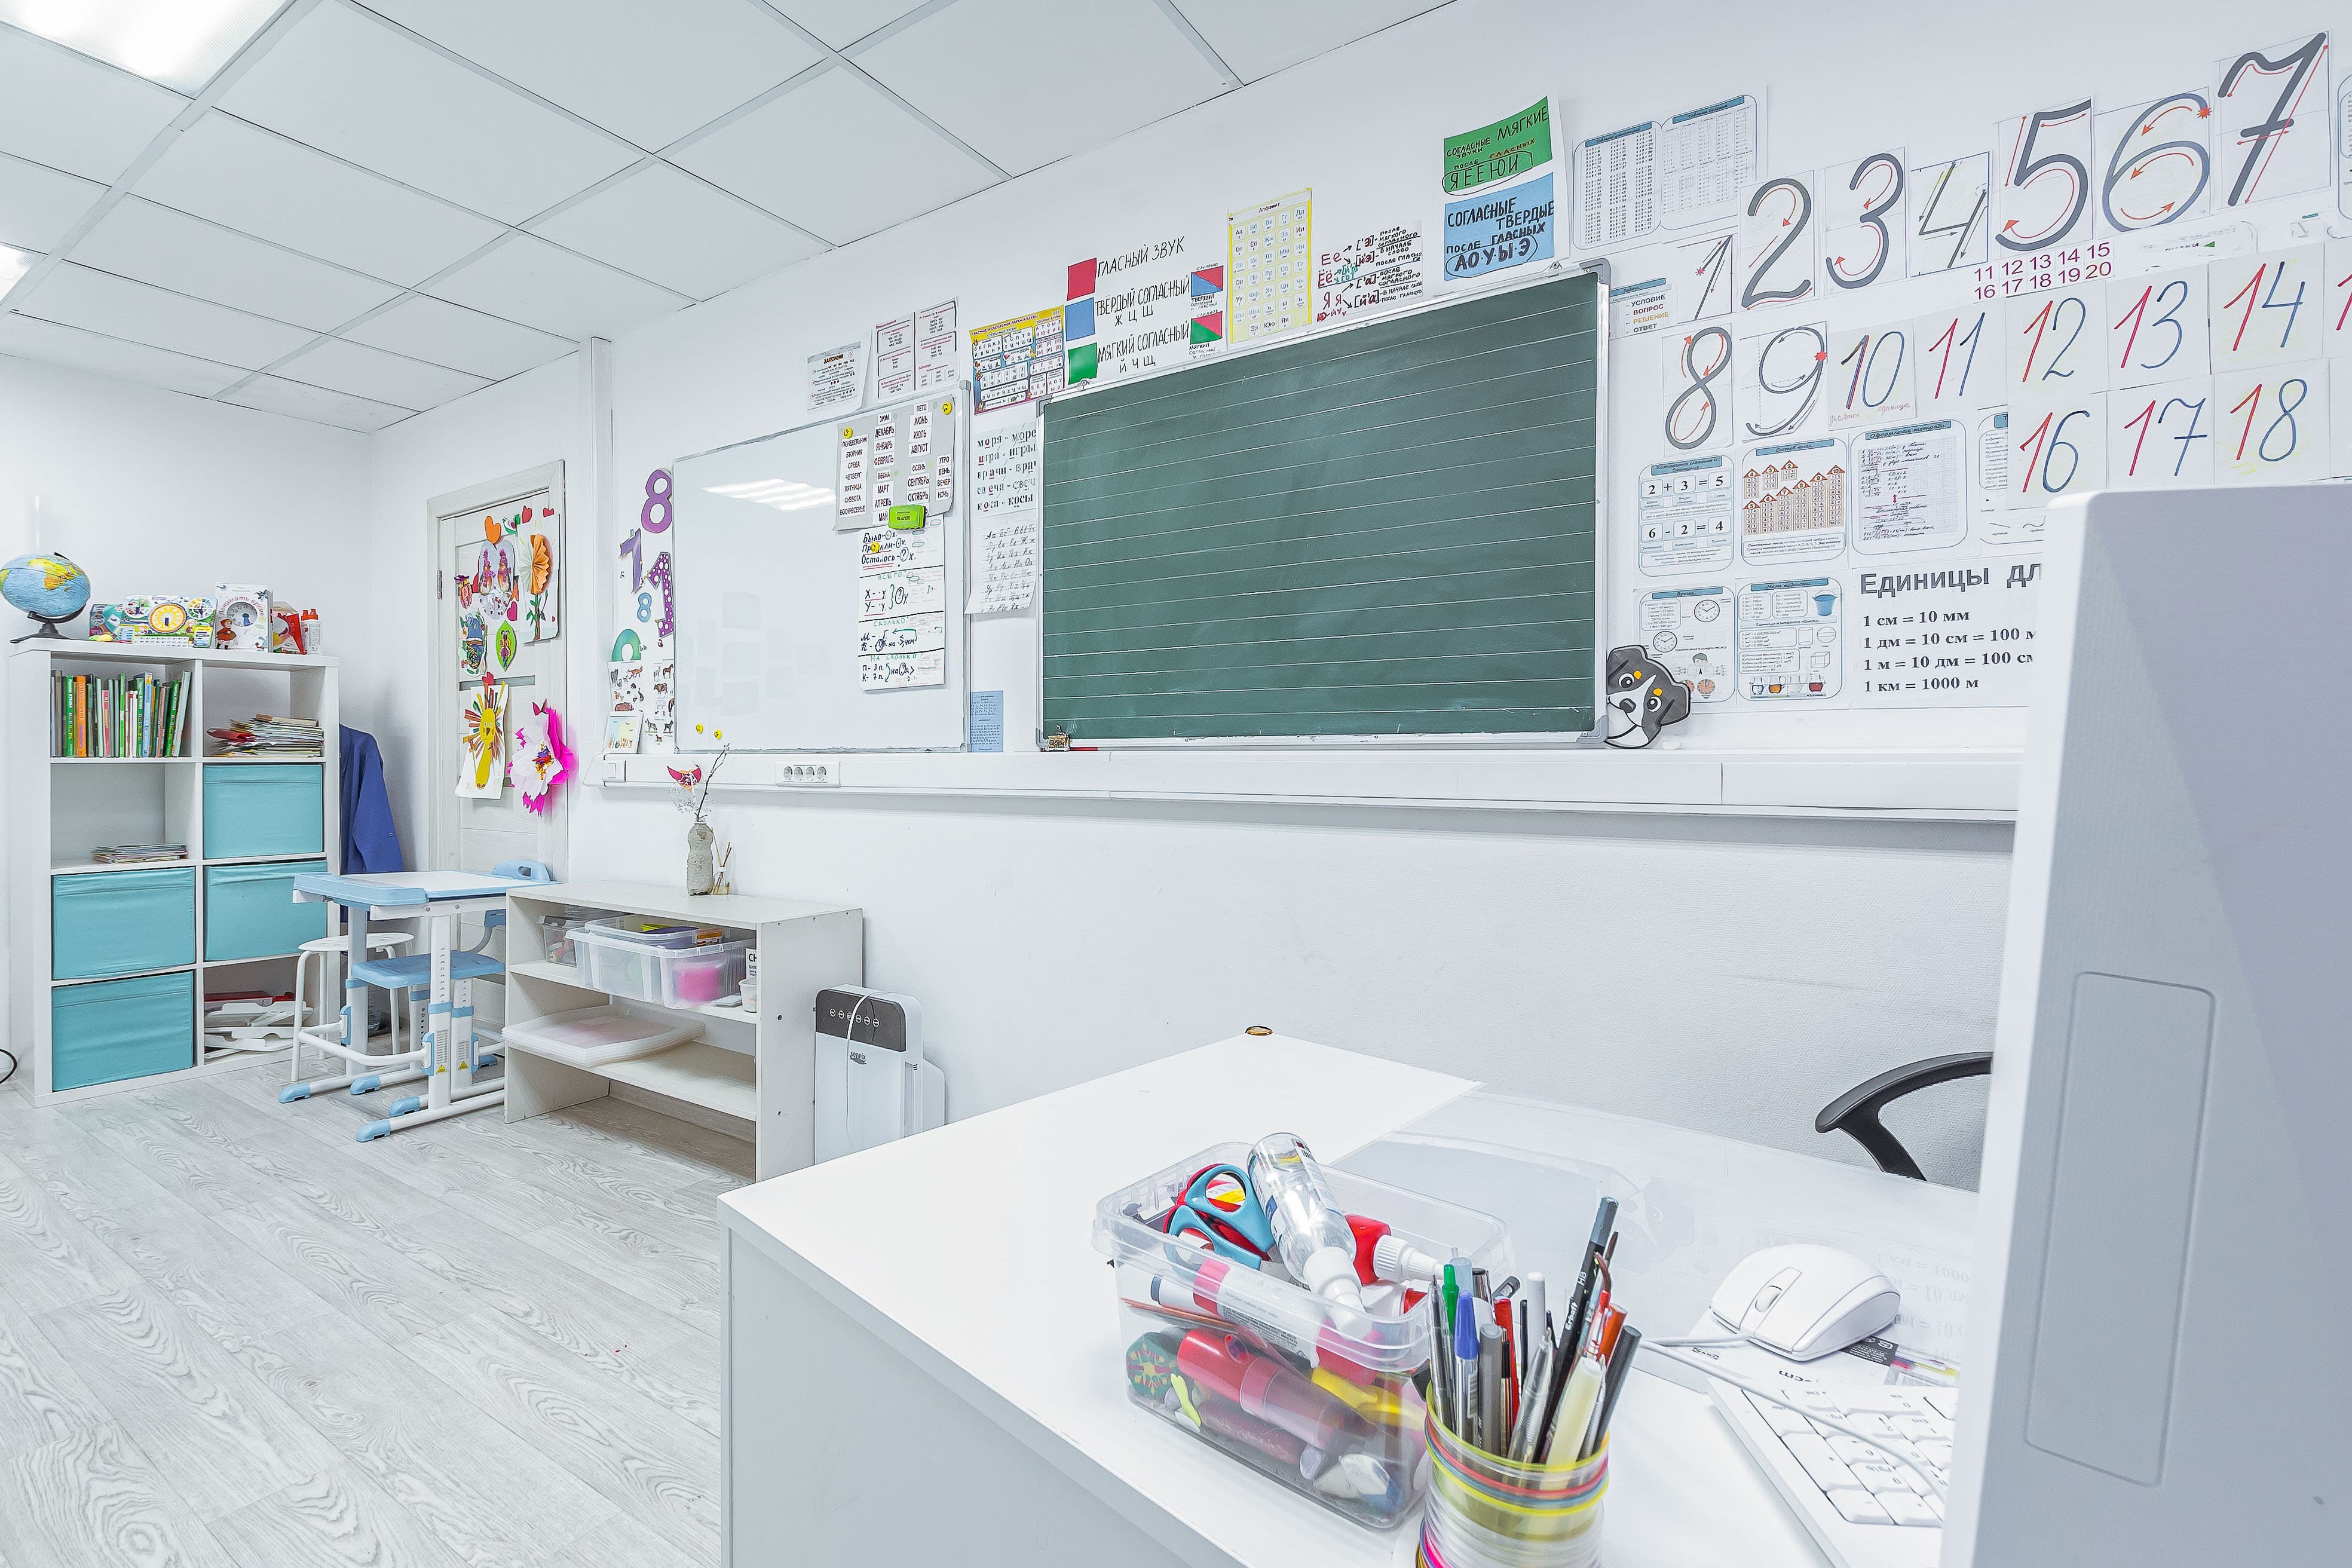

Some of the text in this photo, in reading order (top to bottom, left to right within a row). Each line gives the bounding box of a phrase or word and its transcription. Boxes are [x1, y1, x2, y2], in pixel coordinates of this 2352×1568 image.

[2218, 32, 2326, 207] 7
[1447, 106, 1548, 157] СОГЛАСНЫЕ МЯГКИЕ
[1454, 138, 1536, 170] ПОСЛЕ ГЛАСНЫХ
[1456, 148, 1483, 159] ЗВУКИ
[2102, 93, 2210, 232] 6
[1995, 99, 2091, 252] 5
[1447, 197, 1517, 227] СОГЛАСНЫЕ
[1496, 200, 1554, 231] ТВЕРДЫЕ
[1826, 152, 1904, 289] 3
[1918, 161, 1987, 268] 4
[1379, 229, 1406, 242] МЯГКОГО
[1380, 226, 1400, 236] ПОСЛЕ
[1447, 221, 1546, 254] ПОСЛЕ ГЛАСНЫХ
[1741, 178, 1812, 308] 2
[1097, 235, 1184, 277] ГЛАСНЫЙ ЗВУК
[1376, 258, 1395, 267] ПОСЛЕ
[1974, 243, 2110, 281] 11 12 13 14 15
[1380, 267, 1400, 275] ПОСЛЕ
[1382, 270, 1412, 280] МЯГКОГО
[1138, 274, 1190, 305] СОГЛАСНЫЙ
[1974, 262, 2112, 300] 16 17 18 19 20
[1631, 295, 1665, 307] УСЛОВИЕ
[1633, 304, 1664, 315] ВОПРОС
[2223, 261, 2305, 351] 14
[1114, 305, 1153, 326] Ж Ц Ш
[1633, 312, 1669, 324] РЕШЕНИЕ
[2114, 280, 2188, 369] 13
[1634, 323, 1657, 332] ОТВЕТ
[1098, 334, 1134, 363] МЯГКИЙ
[1138, 320, 1189, 351] СОГЛАСНЫЙ
[2023, 297, 2085, 382] 12
[1120, 355, 1156, 373] Й Ч Щ
[1929, 313, 1984, 399] 11
[1841, 330, 1905, 409] 10
[1665, 326, 1732, 450] 8
[1745, 327, 1825, 436] 9
[880, 414, 890, 422] ЗИМА
[914, 416, 927, 425] ИЮНЬ
[2230, 378, 2307, 461] 18
[842, 436, 868, 447] ПОНЕДЕЛЬНИК
[875, 425, 894, 439] ДЕКАБРЬ
[914, 430, 926, 439] ИЮЛЬ
[977, 428, 1037, 448] моря море
[1870, 428, 1911, 439] Оформление
[2124, 397, 2207, 476] 17
[846, 449, 863, 458] ВТОРНИК
[875, 440, 893, 451] ЯНВАРЬ
[911, 443, 928, 454] АВГУСТ
[979, 443, 1036, 463] игра игры
[2019, 411, 2090, 493] 16
[874, 455, 894, 466] ФЕВРАЛЬ
[912, 463, 925, 471] ОСЕНЬ
[938, 467, 950, 476] ДЕНЬ
[878, 485, 889, 494] МАРТ
[908, 476, 929, 487] СЕНТЯБРЬ
[937, 478, 951, 486] ВЕЧЕР
[1648, 485, 1656, 495] 2
[1681, 480, 1688, 491] 3
[1716, 476, 1723, 486] 5
[641, 468, 672, 534] 8
[875, 499, 892, 508] АПРЕЛЬ
[908, 491, 929, 501] ОКТЯБРЬ
[977, 492, 1033, 511] коса косы
[1649, 528, 1656, 538] 6
[1681, 525, 1688, 535] 2
[1716, 520, 1723, 531] 4
[1861, 563, 2041, 599] Единицы дл
[637, 592, 652, 623] 8
[1863, 615, 1871, 627] 1
[1877, 617, 1898, 626] см
[1919, 611, 1937, 623] 10
[1943, 611, 1970, 621] мм
[1864, 638, 1872, 648] 1
[1877, 637, 1900, 650] дм
[1922, 633, 1940, 645] 10
[1946, 635, 1968, 644] см
[1990, 628, 2020, 641] 100
[1864, 659, 1872, 670] 1
[1878, 661, 1890, 669] м
[1912, 656, 1930, 668] 10
[1935, 658, 1959, 669] дм
[1982, 651, 2011, 665] 100
[1865, 681, 1872, 692] 1
[1878, 682, 1900, 692] км
[1922, 677, 1960, 690] 1000
[1965, 679, 1979, 688] м
[1578, 1271, 1586, 1286] HB
